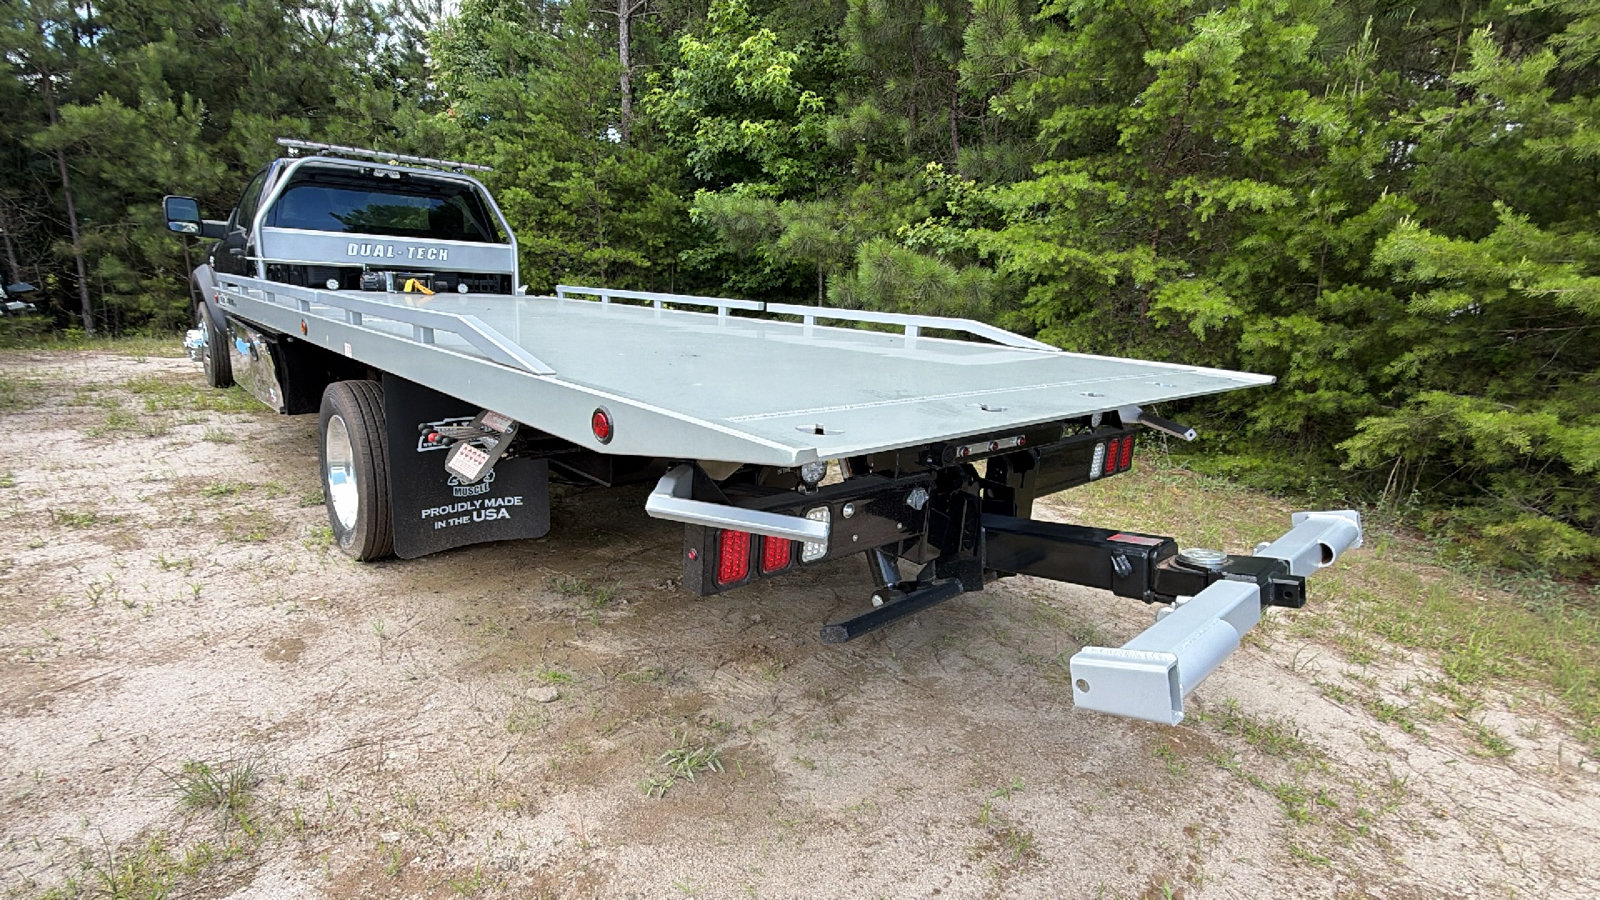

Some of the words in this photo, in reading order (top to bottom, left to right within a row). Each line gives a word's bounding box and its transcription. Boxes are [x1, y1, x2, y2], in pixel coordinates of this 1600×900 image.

[421, 500, 483, 519] PROUDLY
[484, 496, 523, 508] MADE
[434, 520, 446, 530] IN
[448, 515, 471, 526] THE
[472, 507, 511, 522] USA
